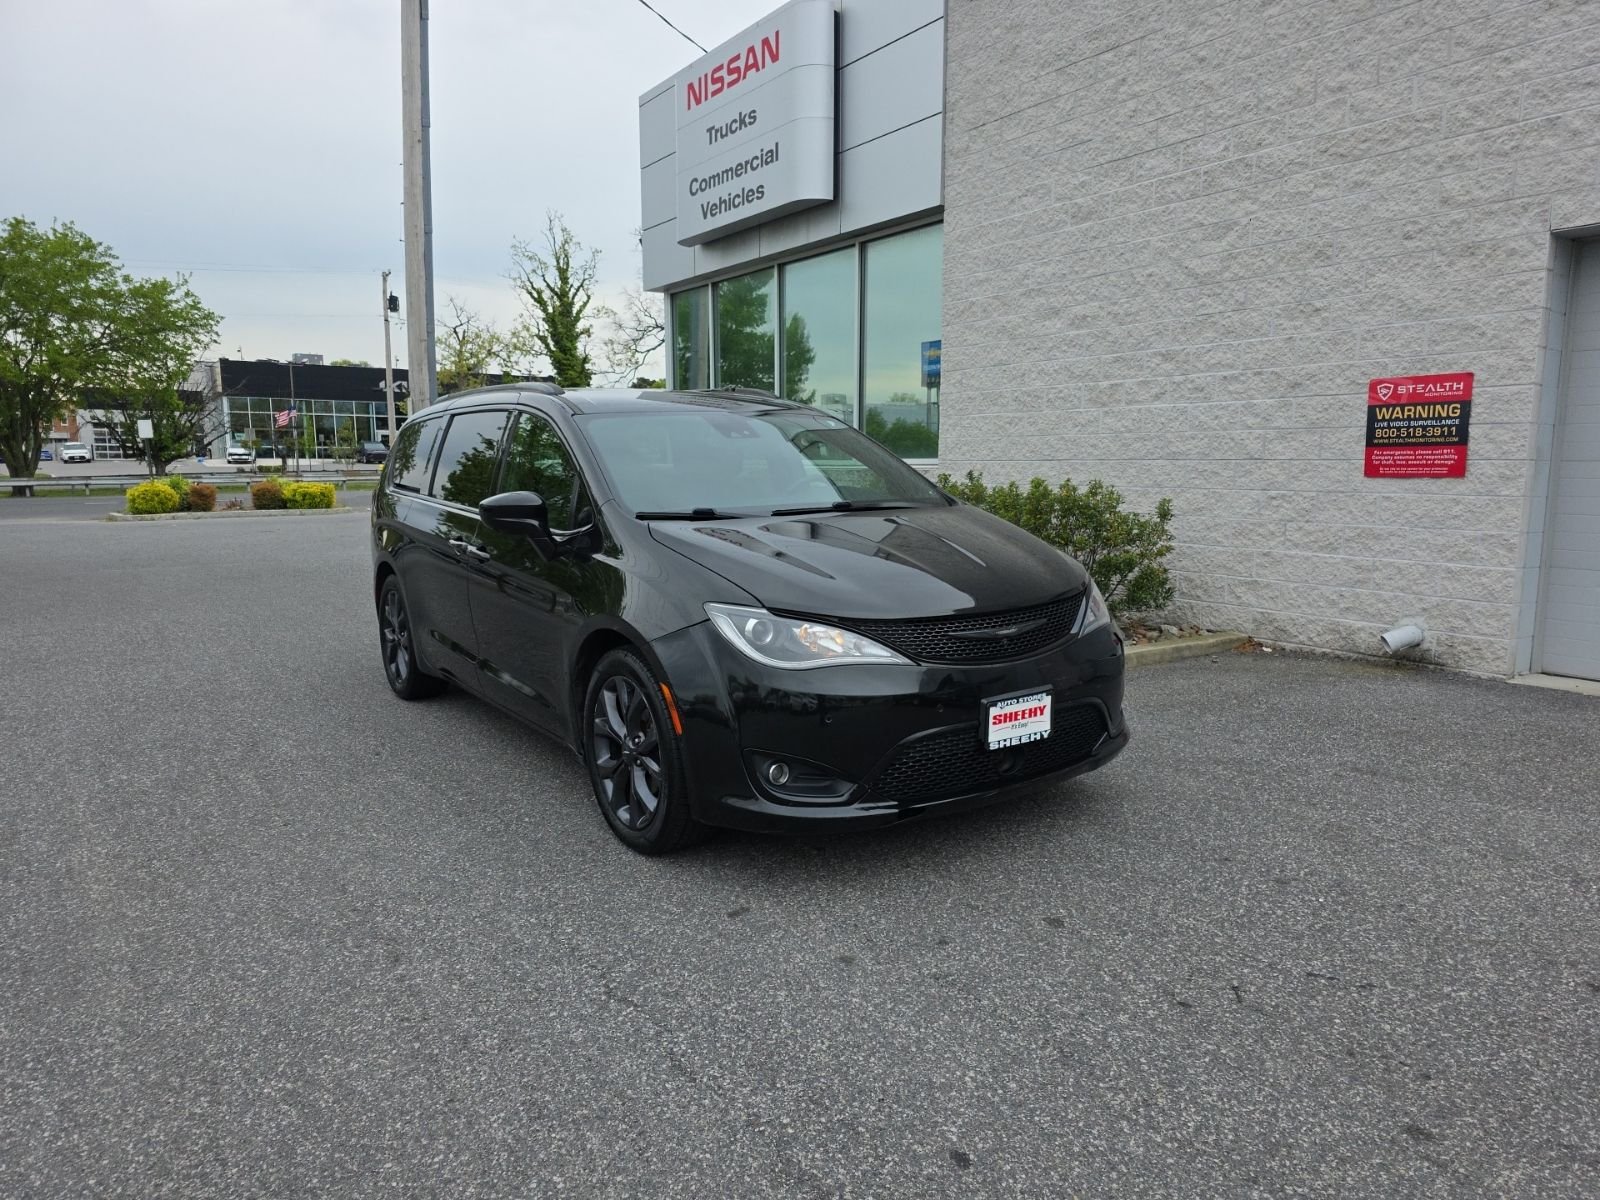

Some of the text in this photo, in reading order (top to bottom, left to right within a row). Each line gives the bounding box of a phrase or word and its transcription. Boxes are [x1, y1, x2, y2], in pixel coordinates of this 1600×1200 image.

[687, 30, 780, 111] NISSAN
[706, 109, 758, 145] Trucks
[689, 142, 779, 197] Commercial
[701, 184, 765, 220] Vehicles
[1397, 382, 1464, 394] STEALTH
[1376, 404, 1461, 420] WARNING
[1375, 427, 1456, 438] 800-518-3911
[996, 699, 1017, 709] AUTO
[992, 705, 1047, 726] SHEEHY
[989, 730, 1052, 751] SHEEHY
